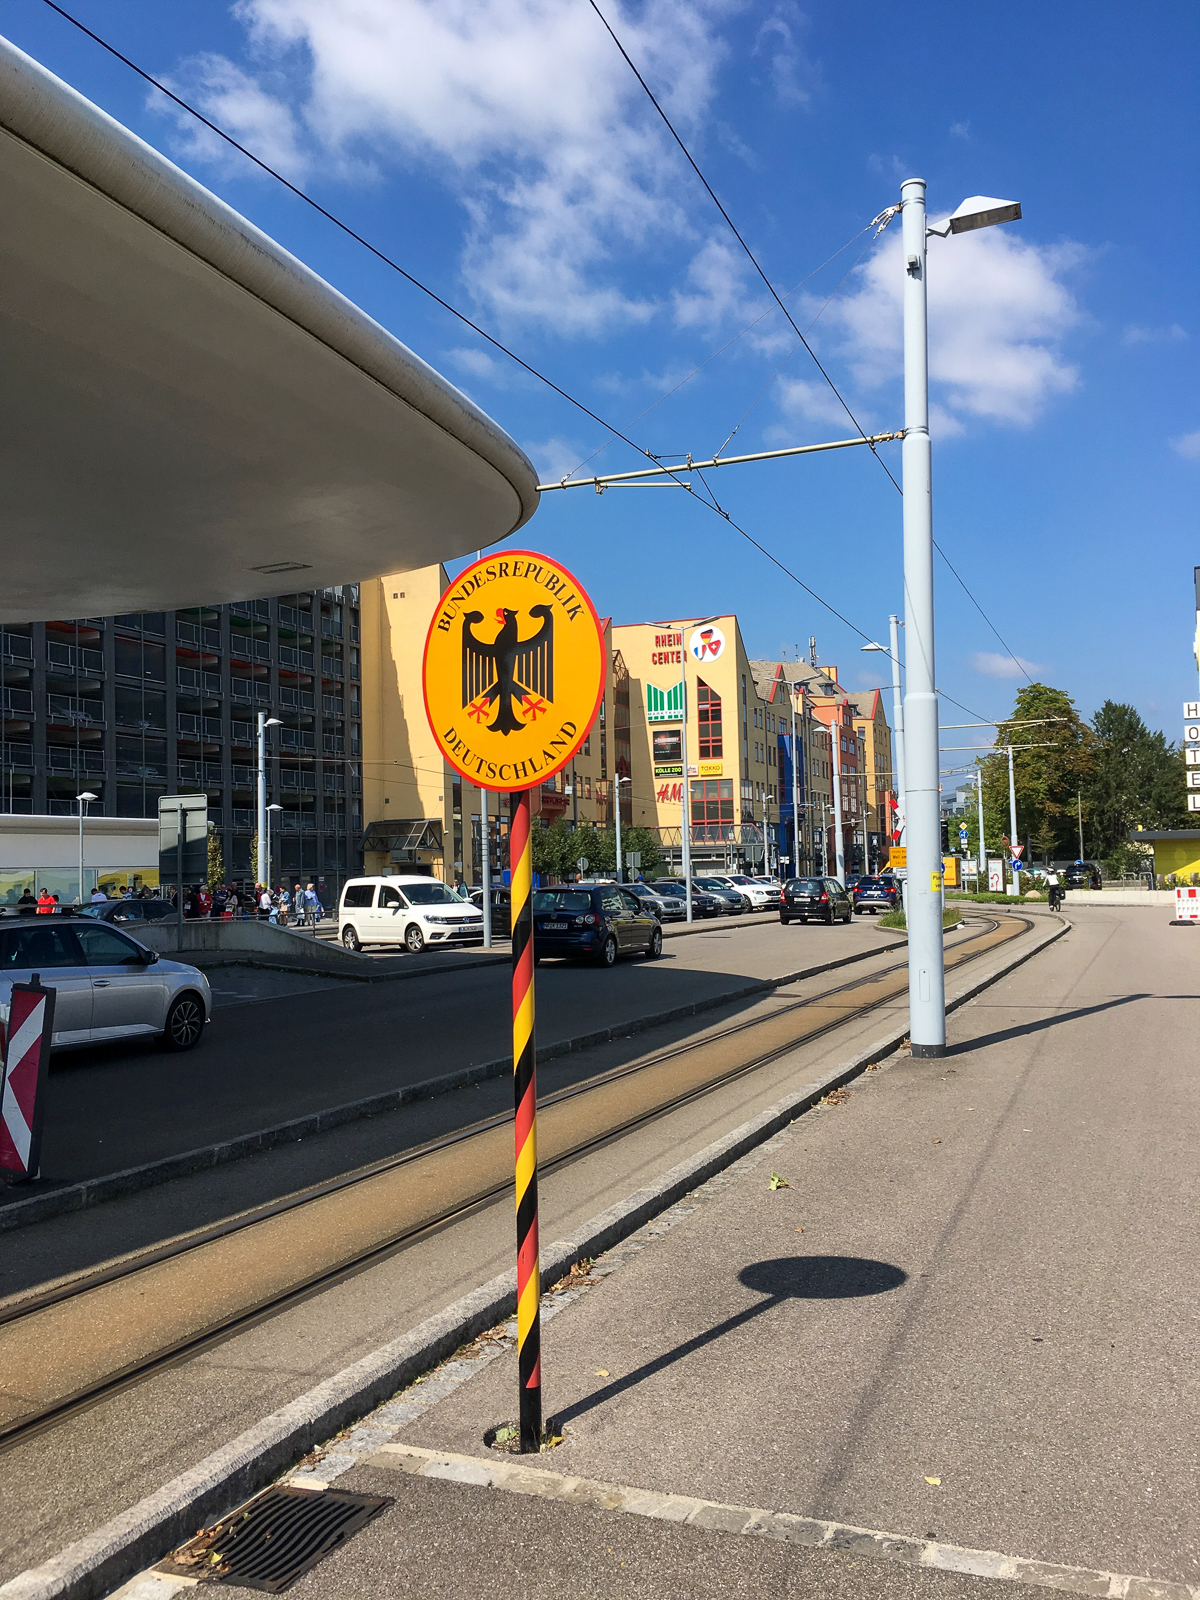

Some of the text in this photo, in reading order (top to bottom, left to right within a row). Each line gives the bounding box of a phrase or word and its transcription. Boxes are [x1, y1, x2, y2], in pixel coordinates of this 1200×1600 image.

[437, 560, 585, 633] BUNDESREPUBLIK
[655, 633, 682, 648] RHEIN
[443, 720, 577, 781] DEUTSCHLAND
[656, 783, 683, 803] H&M
